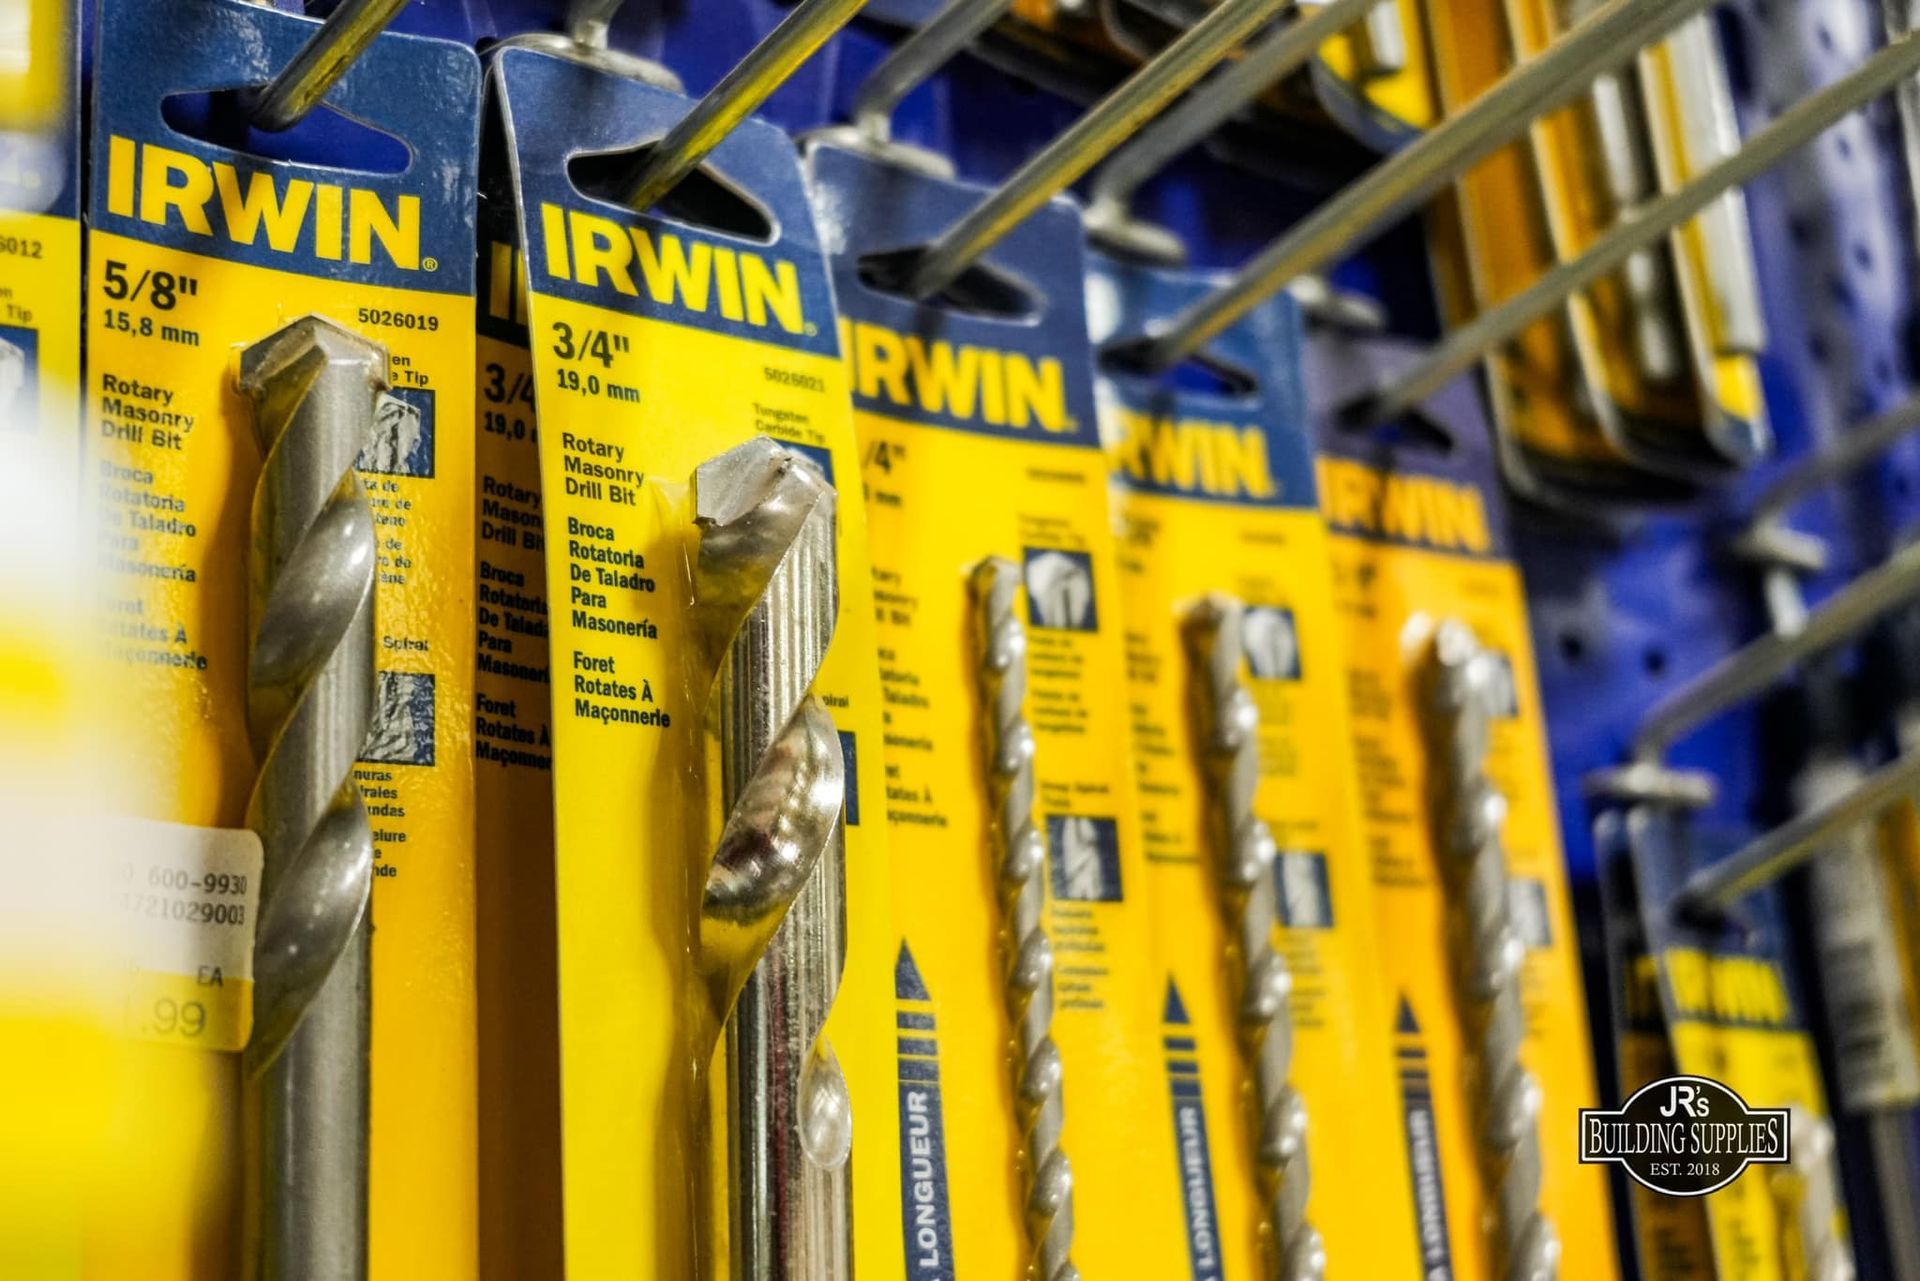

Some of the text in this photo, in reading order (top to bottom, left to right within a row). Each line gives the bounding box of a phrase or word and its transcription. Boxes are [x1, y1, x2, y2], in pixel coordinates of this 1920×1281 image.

[107, 134, 420, 271] IRWIN
[541, 202, 804, 334] IRWIN
[103, 260, 198, 311] 5/8"
[103, 308, 200, 346] 15,8 mm
[358, 307, 439, 331] 5026019
[552, 321, 630, 369] 3/4"
[102, 373, 173, 407] Rotary
[405, 370, 429, 387] Tip
[557, 368, 641, 403] 19,0 mm
[101, 396, 194, 433] Masonry
[484, 410, 525, 441] 19,0
[101, 419, 182, 450] Drill Bit
[562, 432, 624, 463] Rotary
[564, 455, 644, 488] Masonry
[483, 475, 541, 509] Rotary
[565, 476, 636, 506] Drill Bit
[482, 499, 544, 528] Mason
[568, 516, 614, 541] Broca
[482, 521, 516, 546] Drill
[569, 540, 644, 569] Rotatoria
[480, 561, 525, 587] Broca
[570, 563, 655, 593] De Taladro
[571, 586, 607, 608] Para
[479, 606, 499, 627] De
[572, 610, 658, 640] Masonería
[479, 630, 513, 653] Para
[574, 651, 615, 674] Foret
[574, 675, 653, 702] Rotates À
[477, 692, 516, 718] Foret
[575, 698, 671, 729] Maçonnerie
[476, 716, 535, 745] Rotates
[354, 769, 392, 781] nuras
[373, 829, 406, 842] elure
[197, 965, 223, 988] EA
[907, 1091, 939, 1268] LONGUEUR
